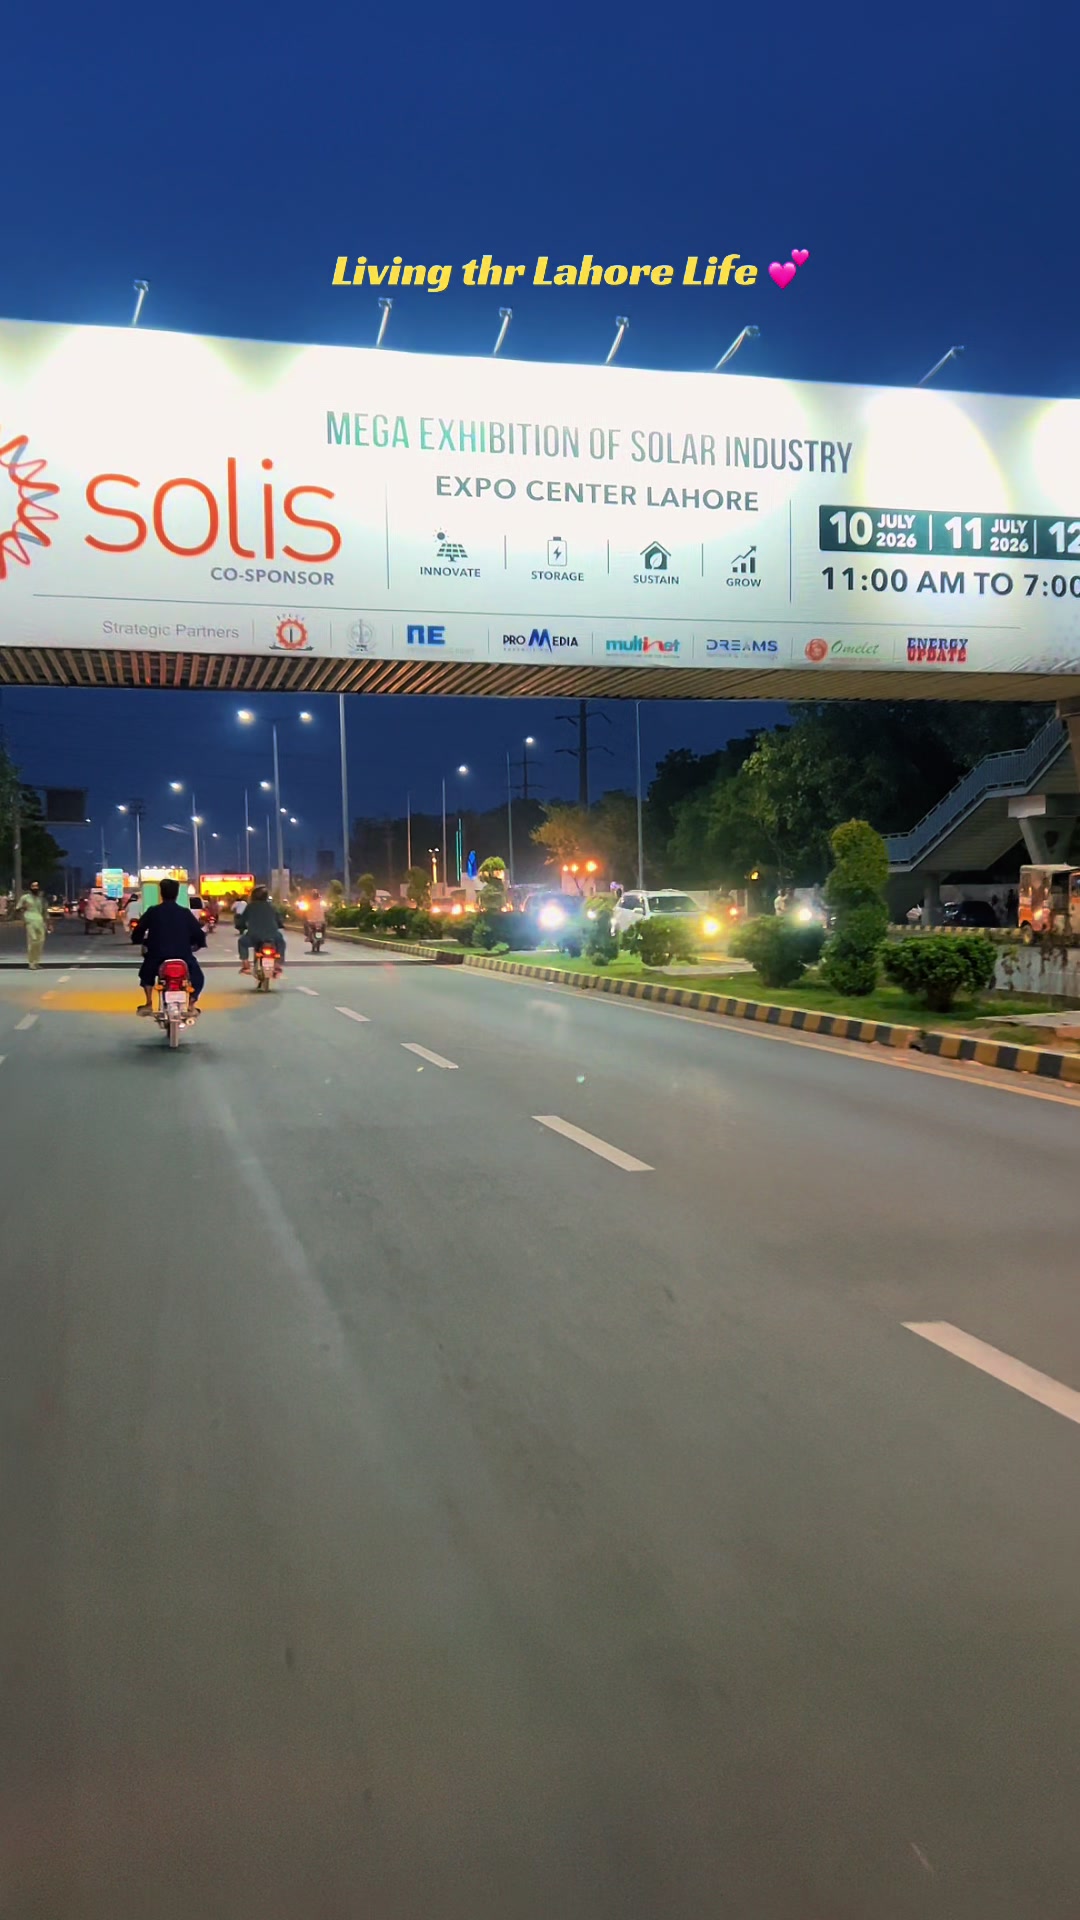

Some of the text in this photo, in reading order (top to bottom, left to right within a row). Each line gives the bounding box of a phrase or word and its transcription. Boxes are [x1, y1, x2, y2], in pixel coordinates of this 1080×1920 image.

[326, 411, 853, 474] MEGA EXHIBITION OF SOLAR INDUSTRY
[436, 476, 759, 512] EXPO CENTER LAHORE
[84, 457, 342, 563] solis
[829, 511, 916, 546] 10 JULY
[944, 516, 1028, 550] 11 JULY
[876, 532, 917, 548] 2026
[990, 537, 1029, 553] 2026
[211, 567, 335, 586] CO-SPONSOR
[419, 566, 481, 578] INNOVATE
[531, 570, 584, 582] STORAGE
[633, 574, 680, 585] SUSTAIN
[726, 578, 762, 588] GROW
[821, 567, 908, 592] 11:00
[916, 571, 965, 594] AM
[973, 572, 1014, 596] TO
[102, 620, 240, 639] Strategic Partners
[706, 639, 778, 652] DREAMS
[831, 640, 880, 655] Omelet
[907, 637, 969, 650] ENERGY
[907, 648, 967, 662] UPDATE
